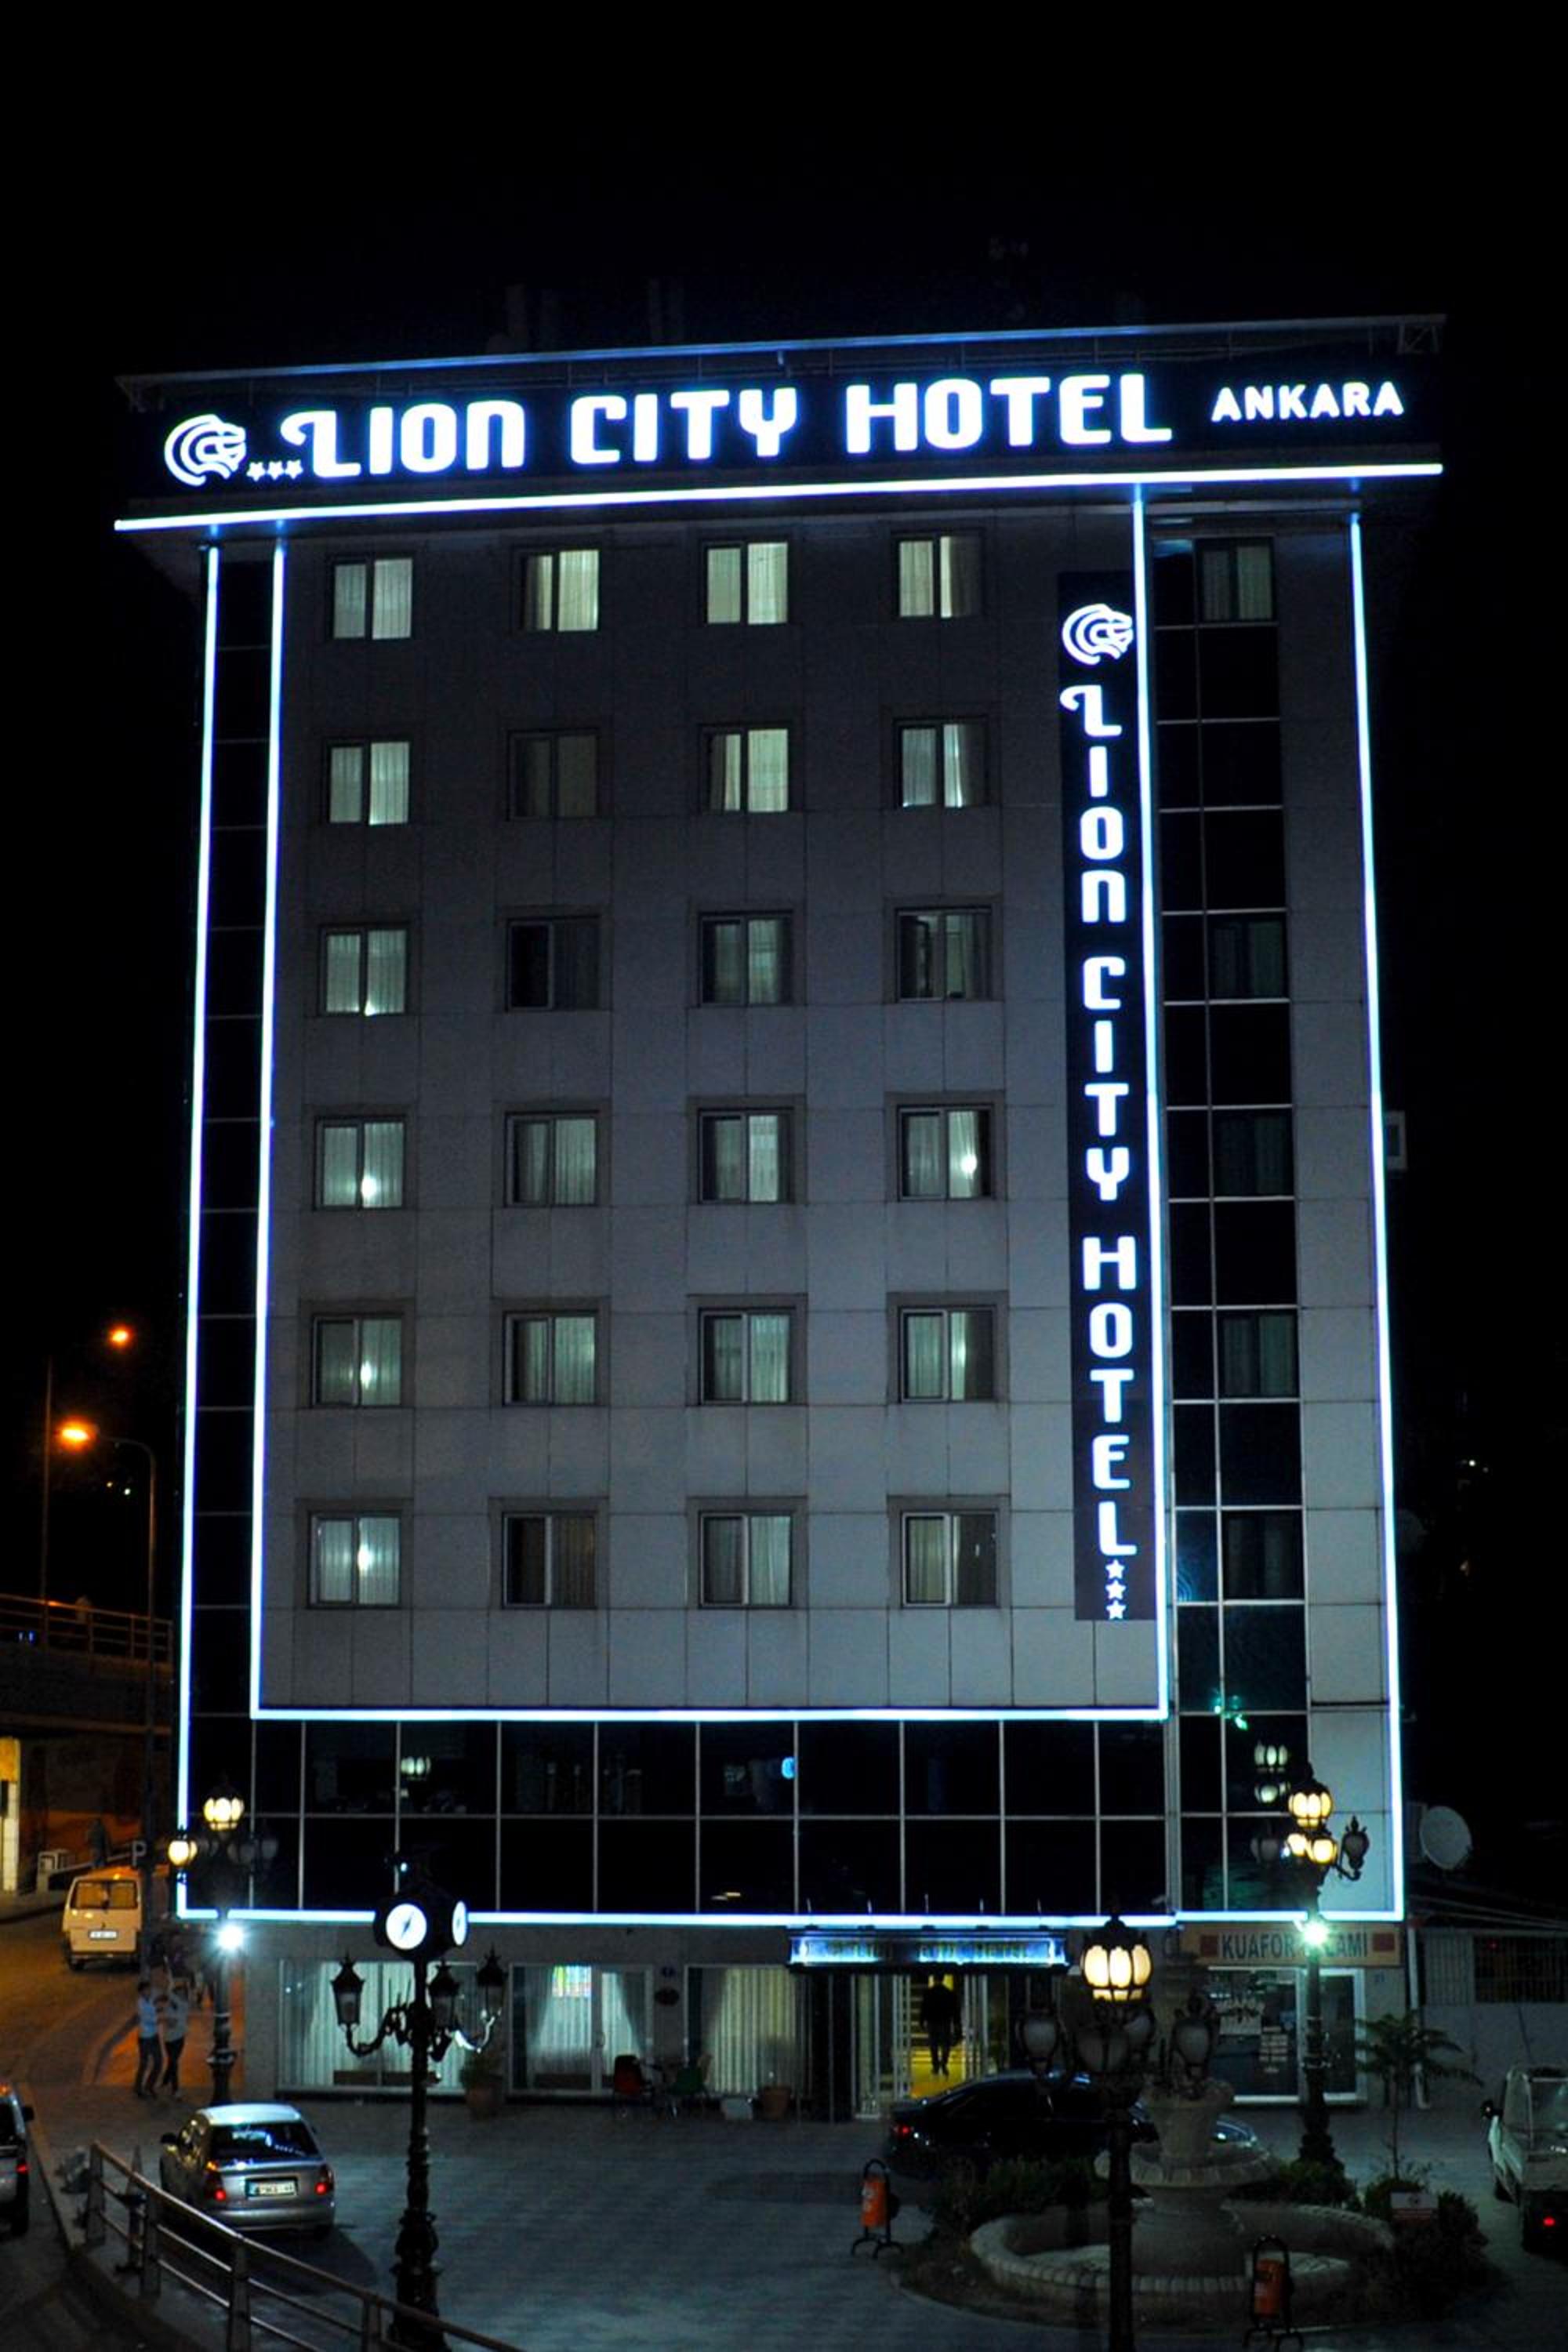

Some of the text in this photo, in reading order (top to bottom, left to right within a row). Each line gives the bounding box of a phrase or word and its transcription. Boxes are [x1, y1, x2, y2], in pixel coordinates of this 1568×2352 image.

[570, 387, 798, 464] CITY
[845, 373, 1173, 454] HOTEL
[1211, 381, 1404, 422] ANKARA
[1083, 956, 1130, 1201] CITY
[1082, 1236, 1138, 1555] HOTEL
[132, 1839, 147, 1867] P
